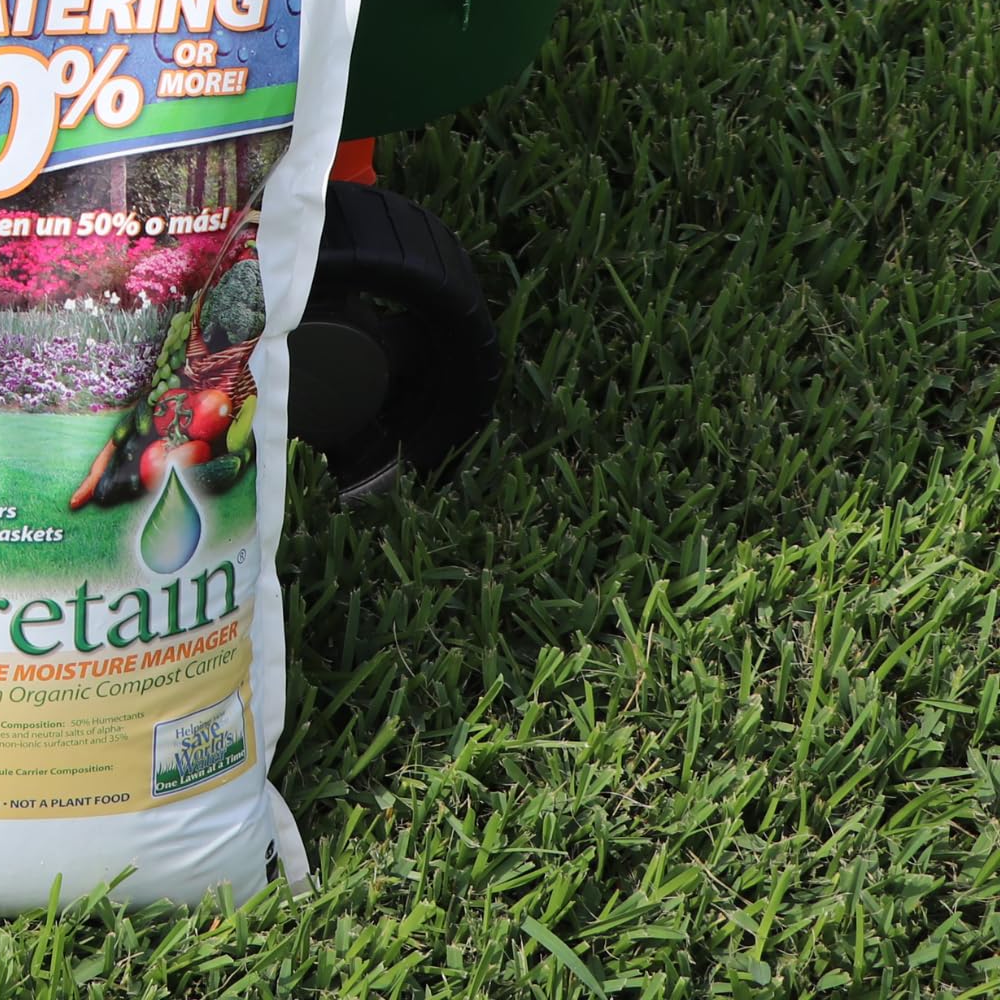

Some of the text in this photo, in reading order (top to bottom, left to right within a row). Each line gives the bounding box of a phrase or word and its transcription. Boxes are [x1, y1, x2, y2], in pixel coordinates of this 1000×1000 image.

[174, 39, 218, 67] OR
[157, 67, 248, 97] MORE!
[36, 216, 72, 237] un
[76, 211, 141, 237] 50%
[145, 216, 163, 236] o
[167, 206, 231, 235] más!
[13, 654, 138, 682] MOISTURE
[141, 621, 238, 671] MANAGER
[9, 684, 92, 707] Organic
[96, 667, 181, 698] Compost
[184, 647, 238, 679] Carrier
[0, 720, 65, 731] Composition:
[92, 711, 145, 726] Humectants
[12, 731, 29, 739] and
[31, 729, 63, 739] neutral
[65, 728, 85, 737] salts
[86, 726, 96, 736] of
[43, 738, 89, 748] surfactant
[90, 737, 107, 745] and
[109, 733, 129, 743] 35%
[181, 721, 221, 749] save
[15, 767, 48, 776] Carrier
[50, 763, 114, 776] Composition:
[156, 779, 178, 791] One
[180, 769, 205, 785] Lawn
[207, 765, 217, 774] at
[10, 799, 37, 808] NOT
[39, 799, 48, 808] A
[50, 796, 92, 807] PLANT
[94, 792, 131, 805] FOOD
